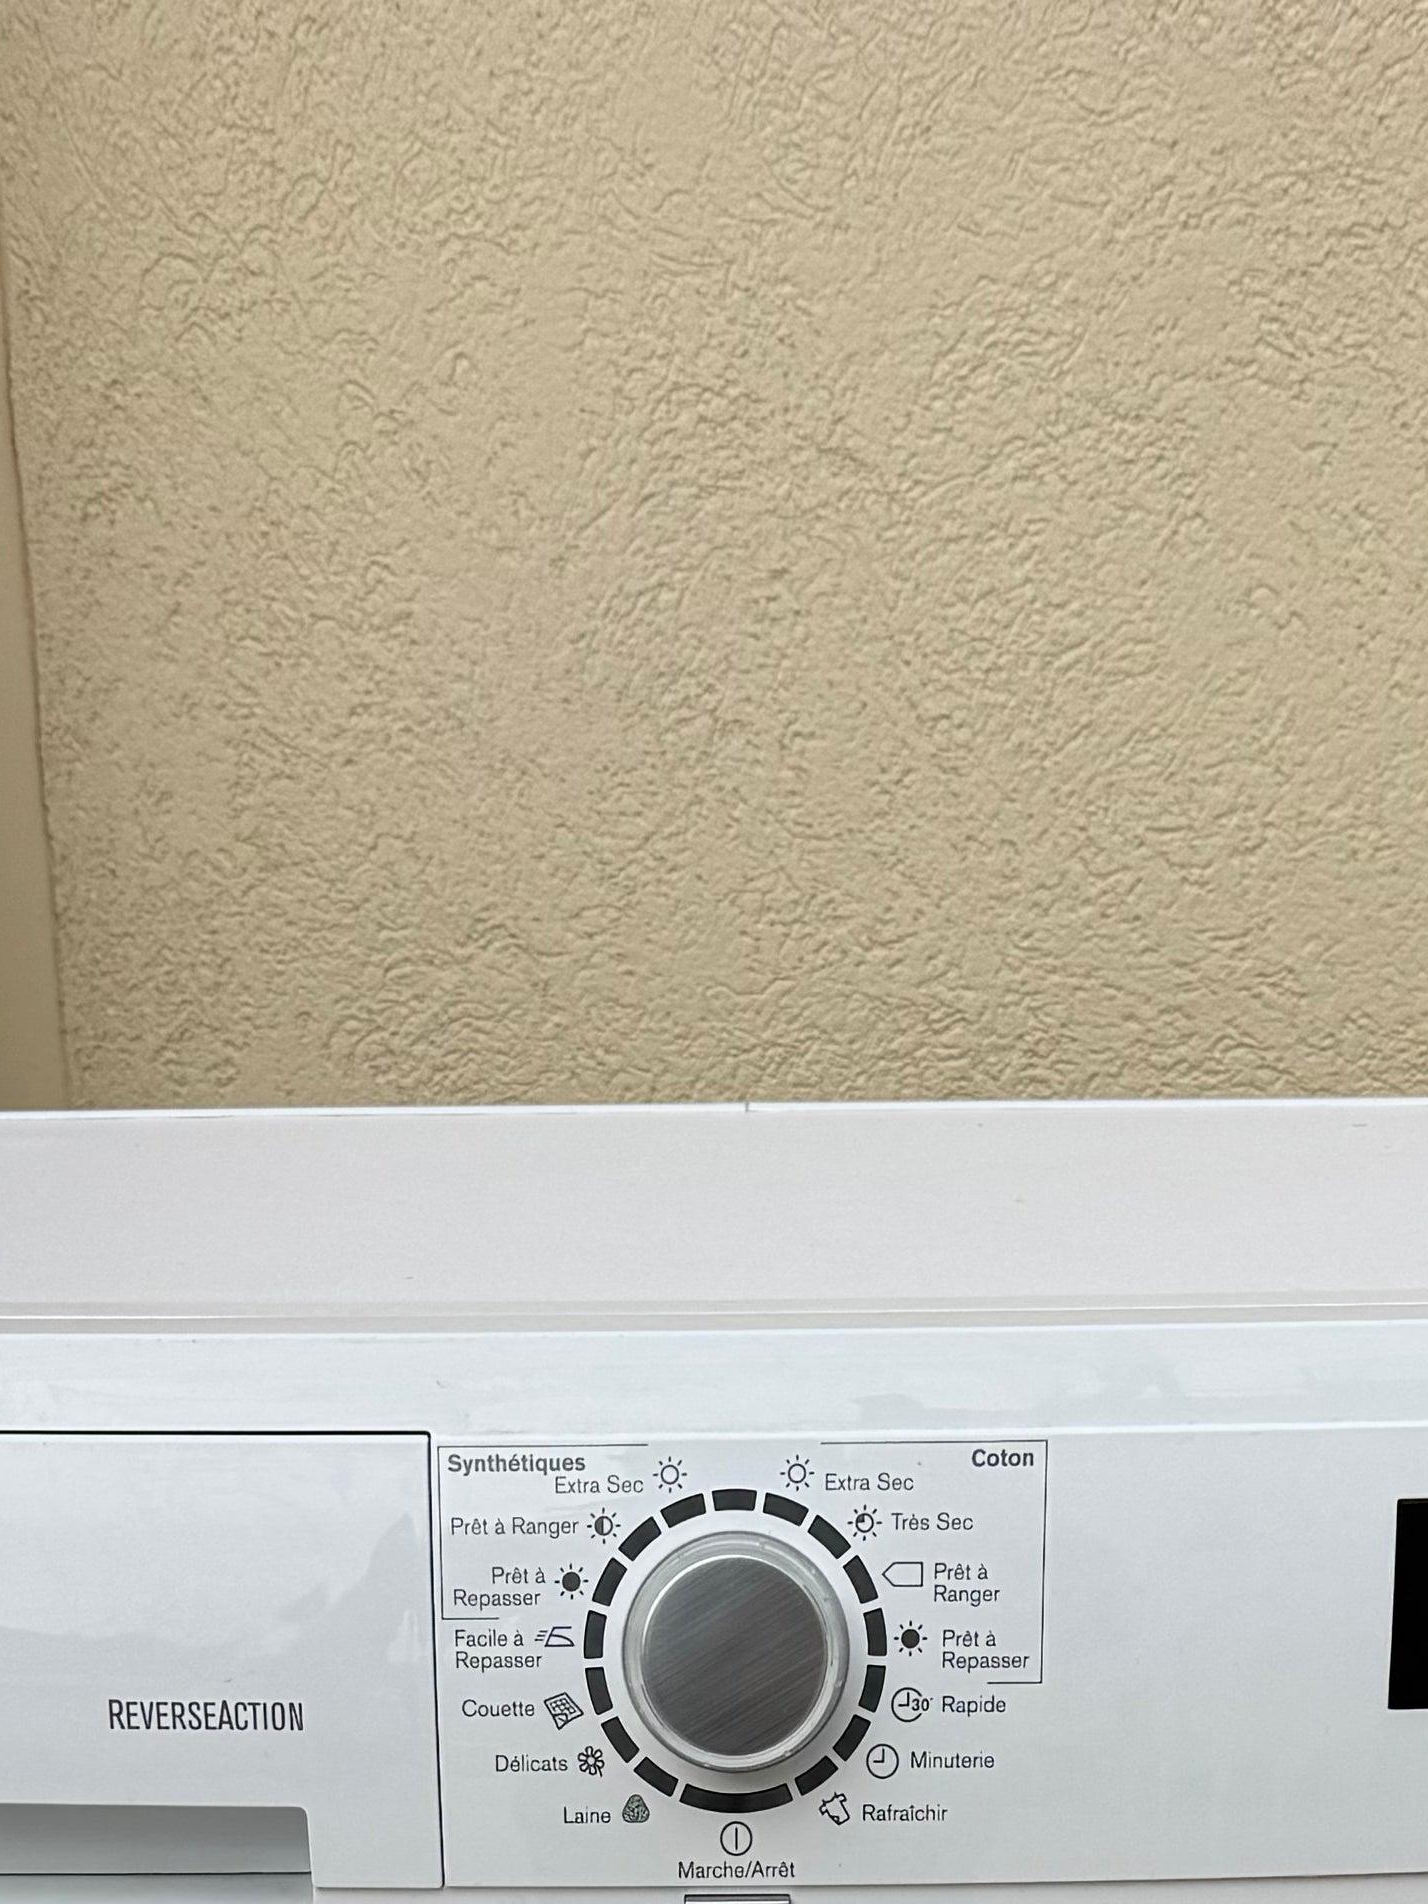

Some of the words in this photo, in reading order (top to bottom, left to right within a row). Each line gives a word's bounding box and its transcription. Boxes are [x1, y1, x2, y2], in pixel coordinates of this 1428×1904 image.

[447, 1453, 586, 1475] Synthétiques
[971, 1448, 1034, 1468] Coton
[554, 1475, 601, 1495] Extra
[607, 1474, 644, 1494] Sec
[825, 1472, 871, 1492] Extra
[876, 1472, 914, 1492] Sec
[450, 1516, 488, 1536] Prêt
[494, 1517, 506, 1536] à
[512, 1516, 580, 1540] Ranger
[890, 1512, 930, 1531] Très
[936, 1511, 974, 1531] Sec
[491, 1566, 529, 1585] Prêt
[534, 1566, 547, 1584] à
[933, 1562, 971, 1581] Prêt
[977, 1562, 989, 1581] à
[453, 1588, 541, 1610] Repasser
[933, 1584, 1001, 1606] Ranger
[454, 1628, 508, 1648] Facile
[513, 1629, 525, 1647] à
[942, 1629, 980, 1648] Prêt
[985, 1630, 997, 1647] à
[455, 1650, 543, 1673] Repasser
[942, 1651, 1030, 1672] Repasser
[461, 1699, 535, 1718] Couette
[941, 1694, 1007, 1717] Rapide
[495, 1754, 569, 1773] Délicats
[910, 1750, 995, 1769] Minuterie
[563, 1806, 612, 1825] Laine
[862, 1803, 949, 1822] Rafraîchir
[678, 1860, 796, 1879] Marche/Arrêt
